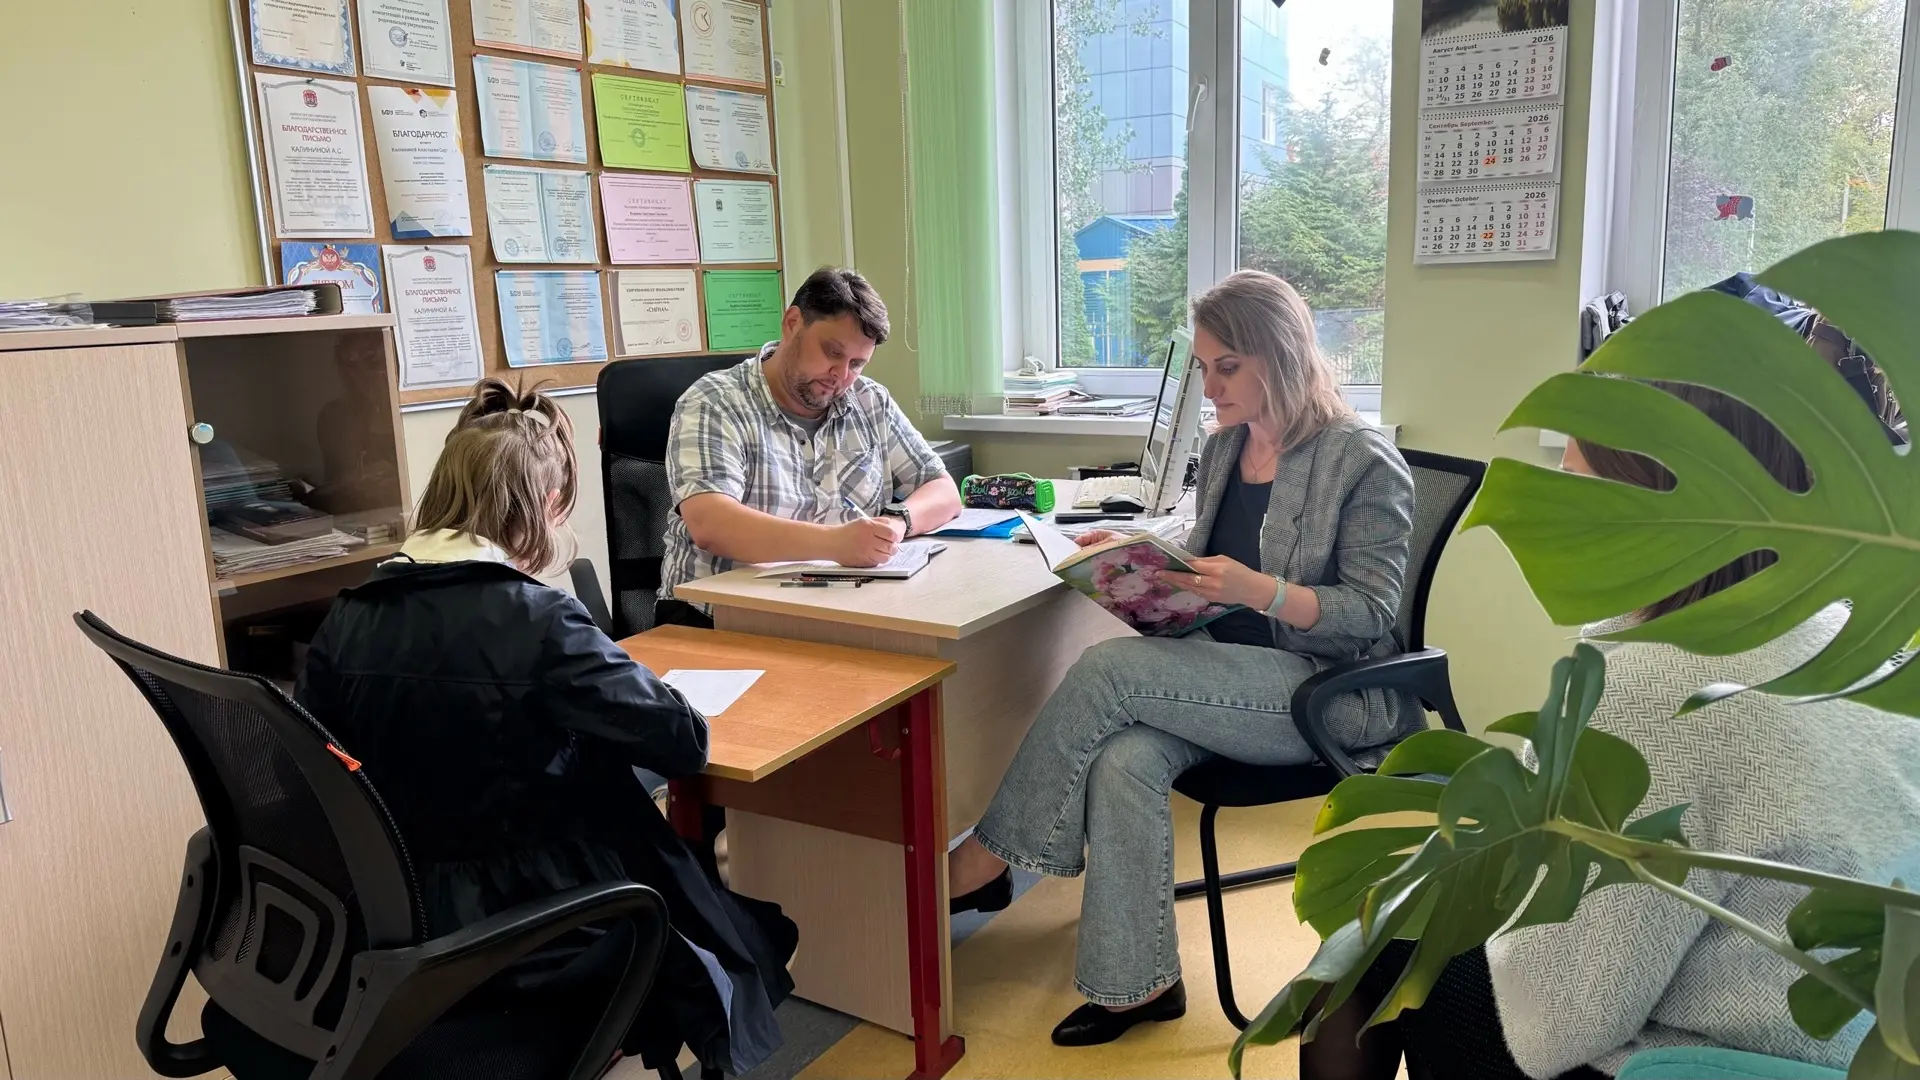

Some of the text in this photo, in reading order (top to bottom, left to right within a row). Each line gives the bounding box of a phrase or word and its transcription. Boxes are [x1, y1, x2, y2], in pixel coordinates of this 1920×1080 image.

[1532, 35, 1554, 44] 2026
[1478, 63, 1484, 71] 5
[1531, 57, 1536, 65] 8
[1528, 114, 1549, 122] 2026
[282, 124, 348, 135] БЛАГОДАРСТВЕННОЕ
[302, 135, 331, 143] ПИСЬМО
[392, 130, 448, 139] БЛАГОДАРНОСТ
